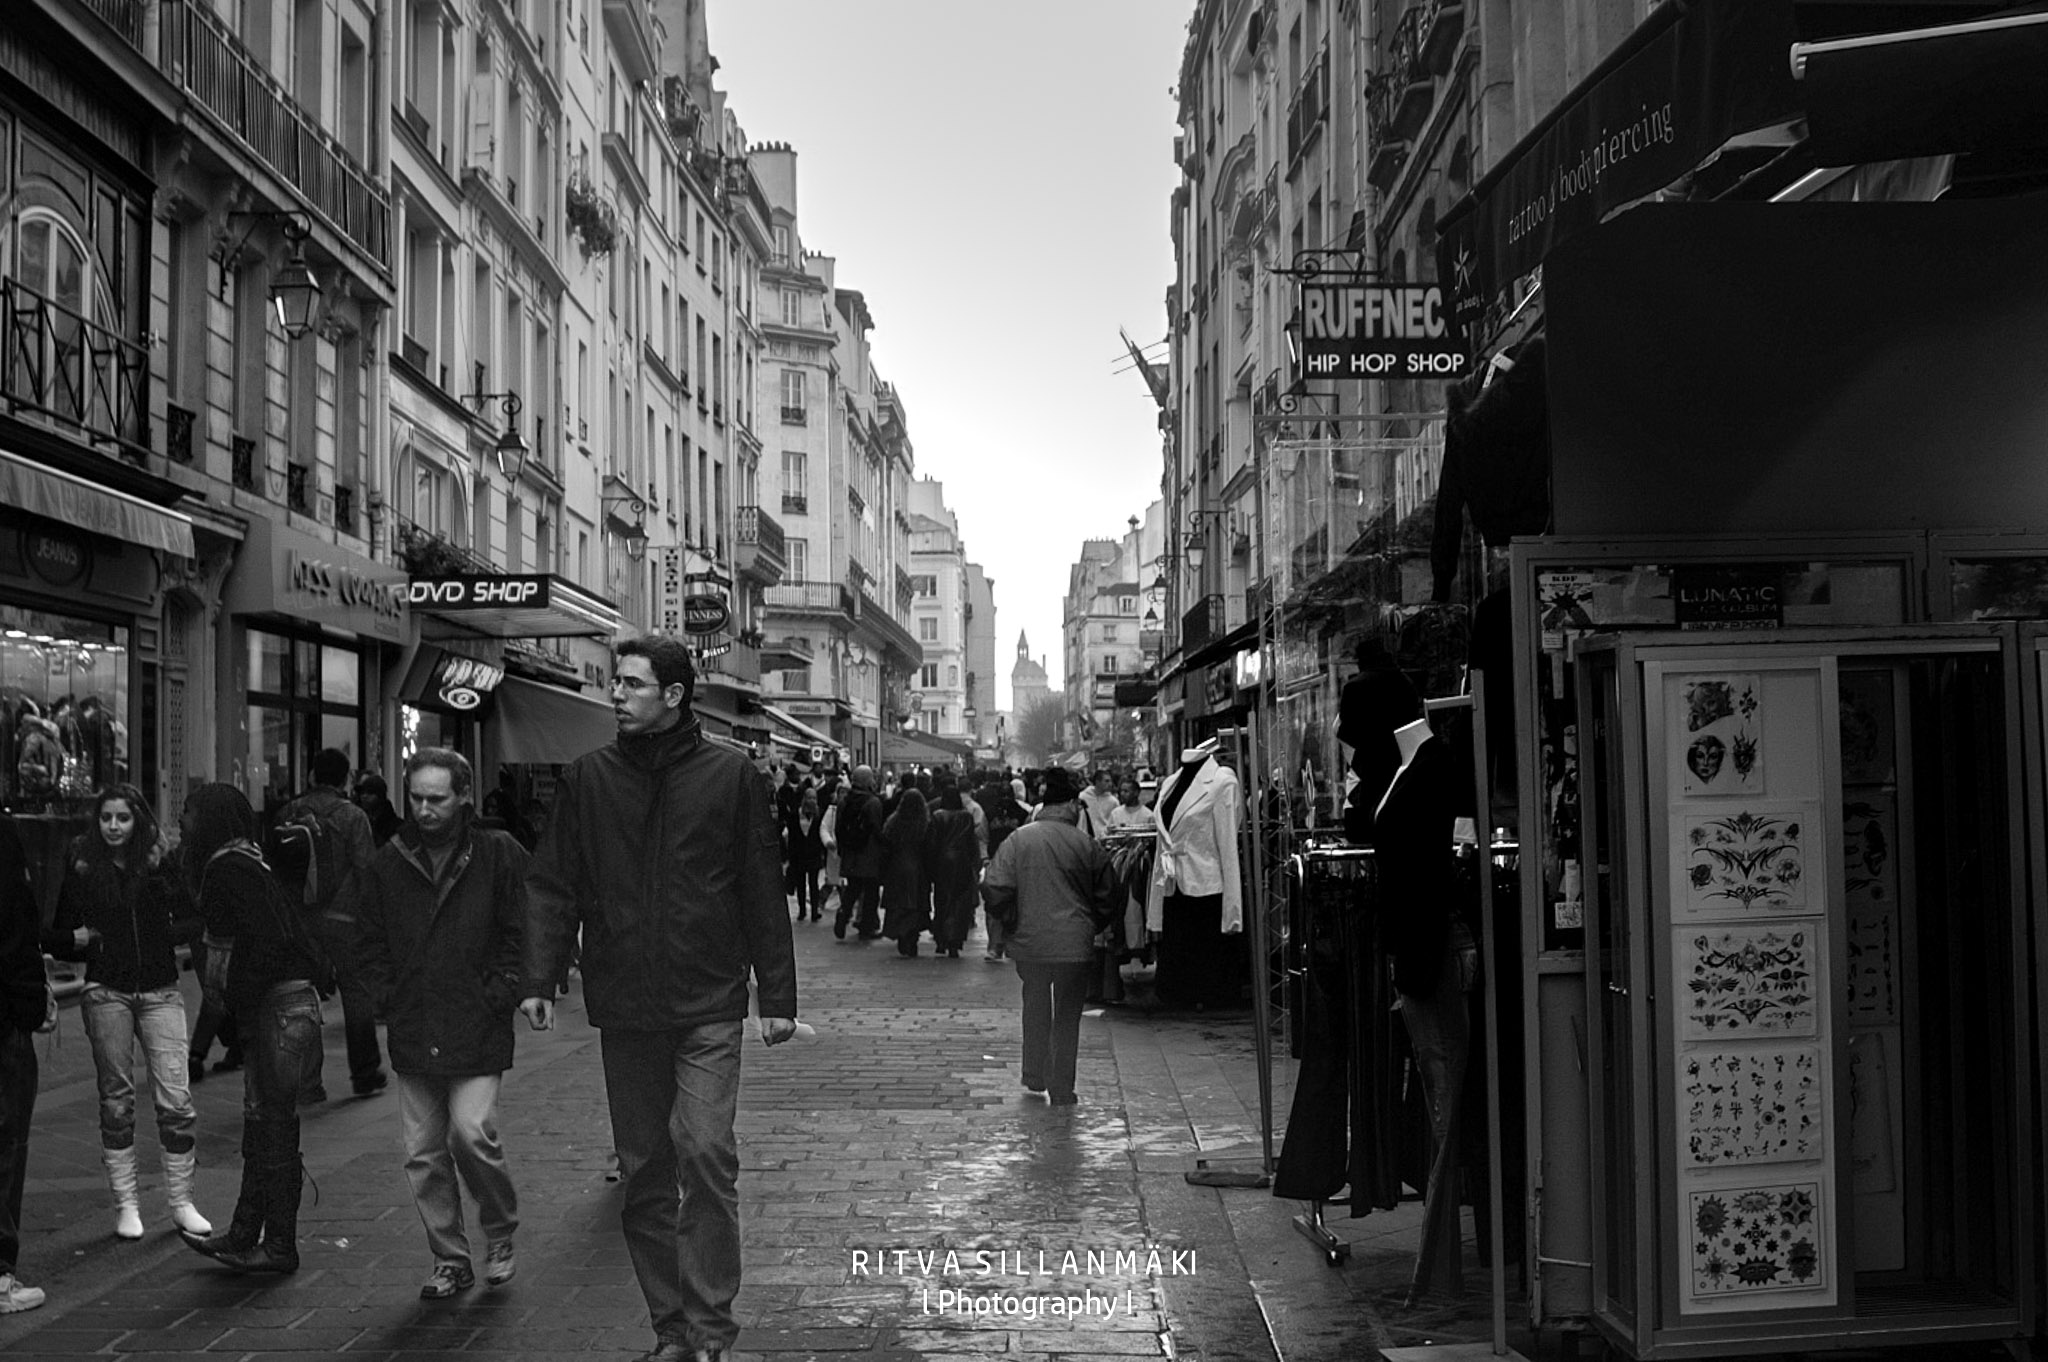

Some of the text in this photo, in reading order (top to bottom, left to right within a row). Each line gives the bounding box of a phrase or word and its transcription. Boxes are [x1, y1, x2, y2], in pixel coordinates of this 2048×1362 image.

[1507, 196, 1547, 244] tattoo
[1303, 286, 1469, 340] RUFFNEC
[1307, 353, 1466, 373] HIP HOP SHOP
[409, 581, 539, 603] DVD SHOP
[1679, 586, 1776, 603] LUNATIC
[684, 609, 723, 621] UINNESS
